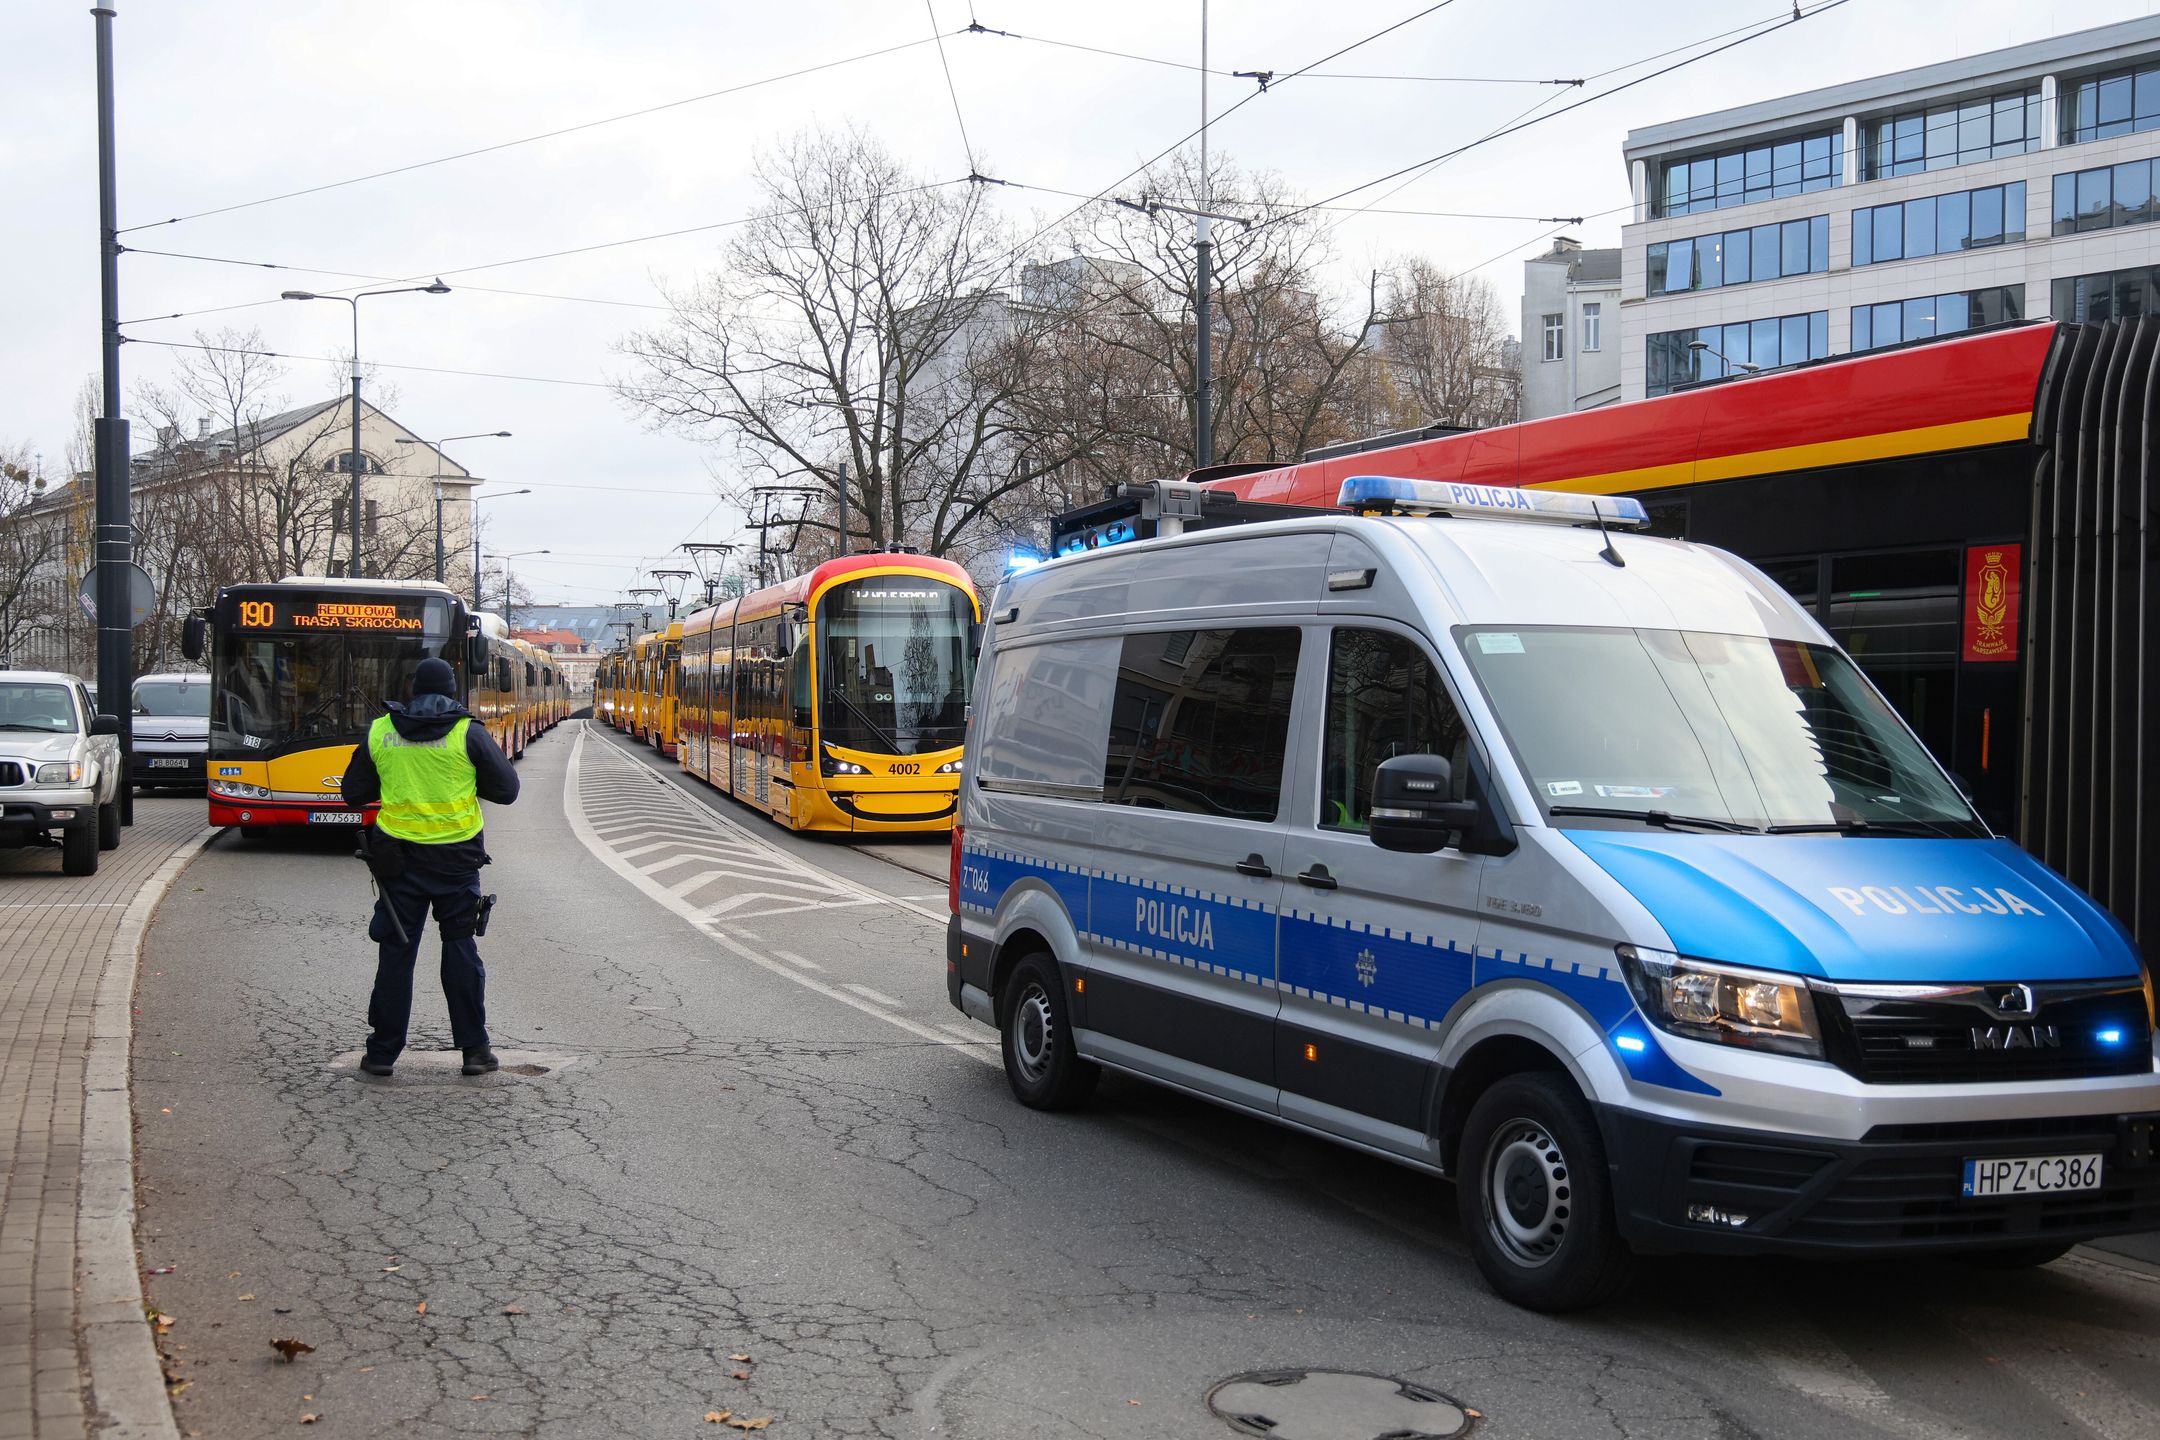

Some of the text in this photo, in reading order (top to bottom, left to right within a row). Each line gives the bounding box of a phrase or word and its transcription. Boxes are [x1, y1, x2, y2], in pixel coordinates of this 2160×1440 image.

[1451, 485, 1530, 510] POLICJA
[240, 602, 274, 627] 190
[293, 616, 339, 627] TRASA
[318, 604, 395, 617] REDUTOWA
[245, 735, 260, 748] 018
[888, 763, 920, 775] 4002
[315, 813, 361, 822] WX 75633
[1826, 886, 2046, 916] POLICJA
[1136, 896, 1214, 950] POLICJA
[1970, 1026, 2060, 1050] MAN
[1979, 1157, 2097, 1193] HPZ C386
